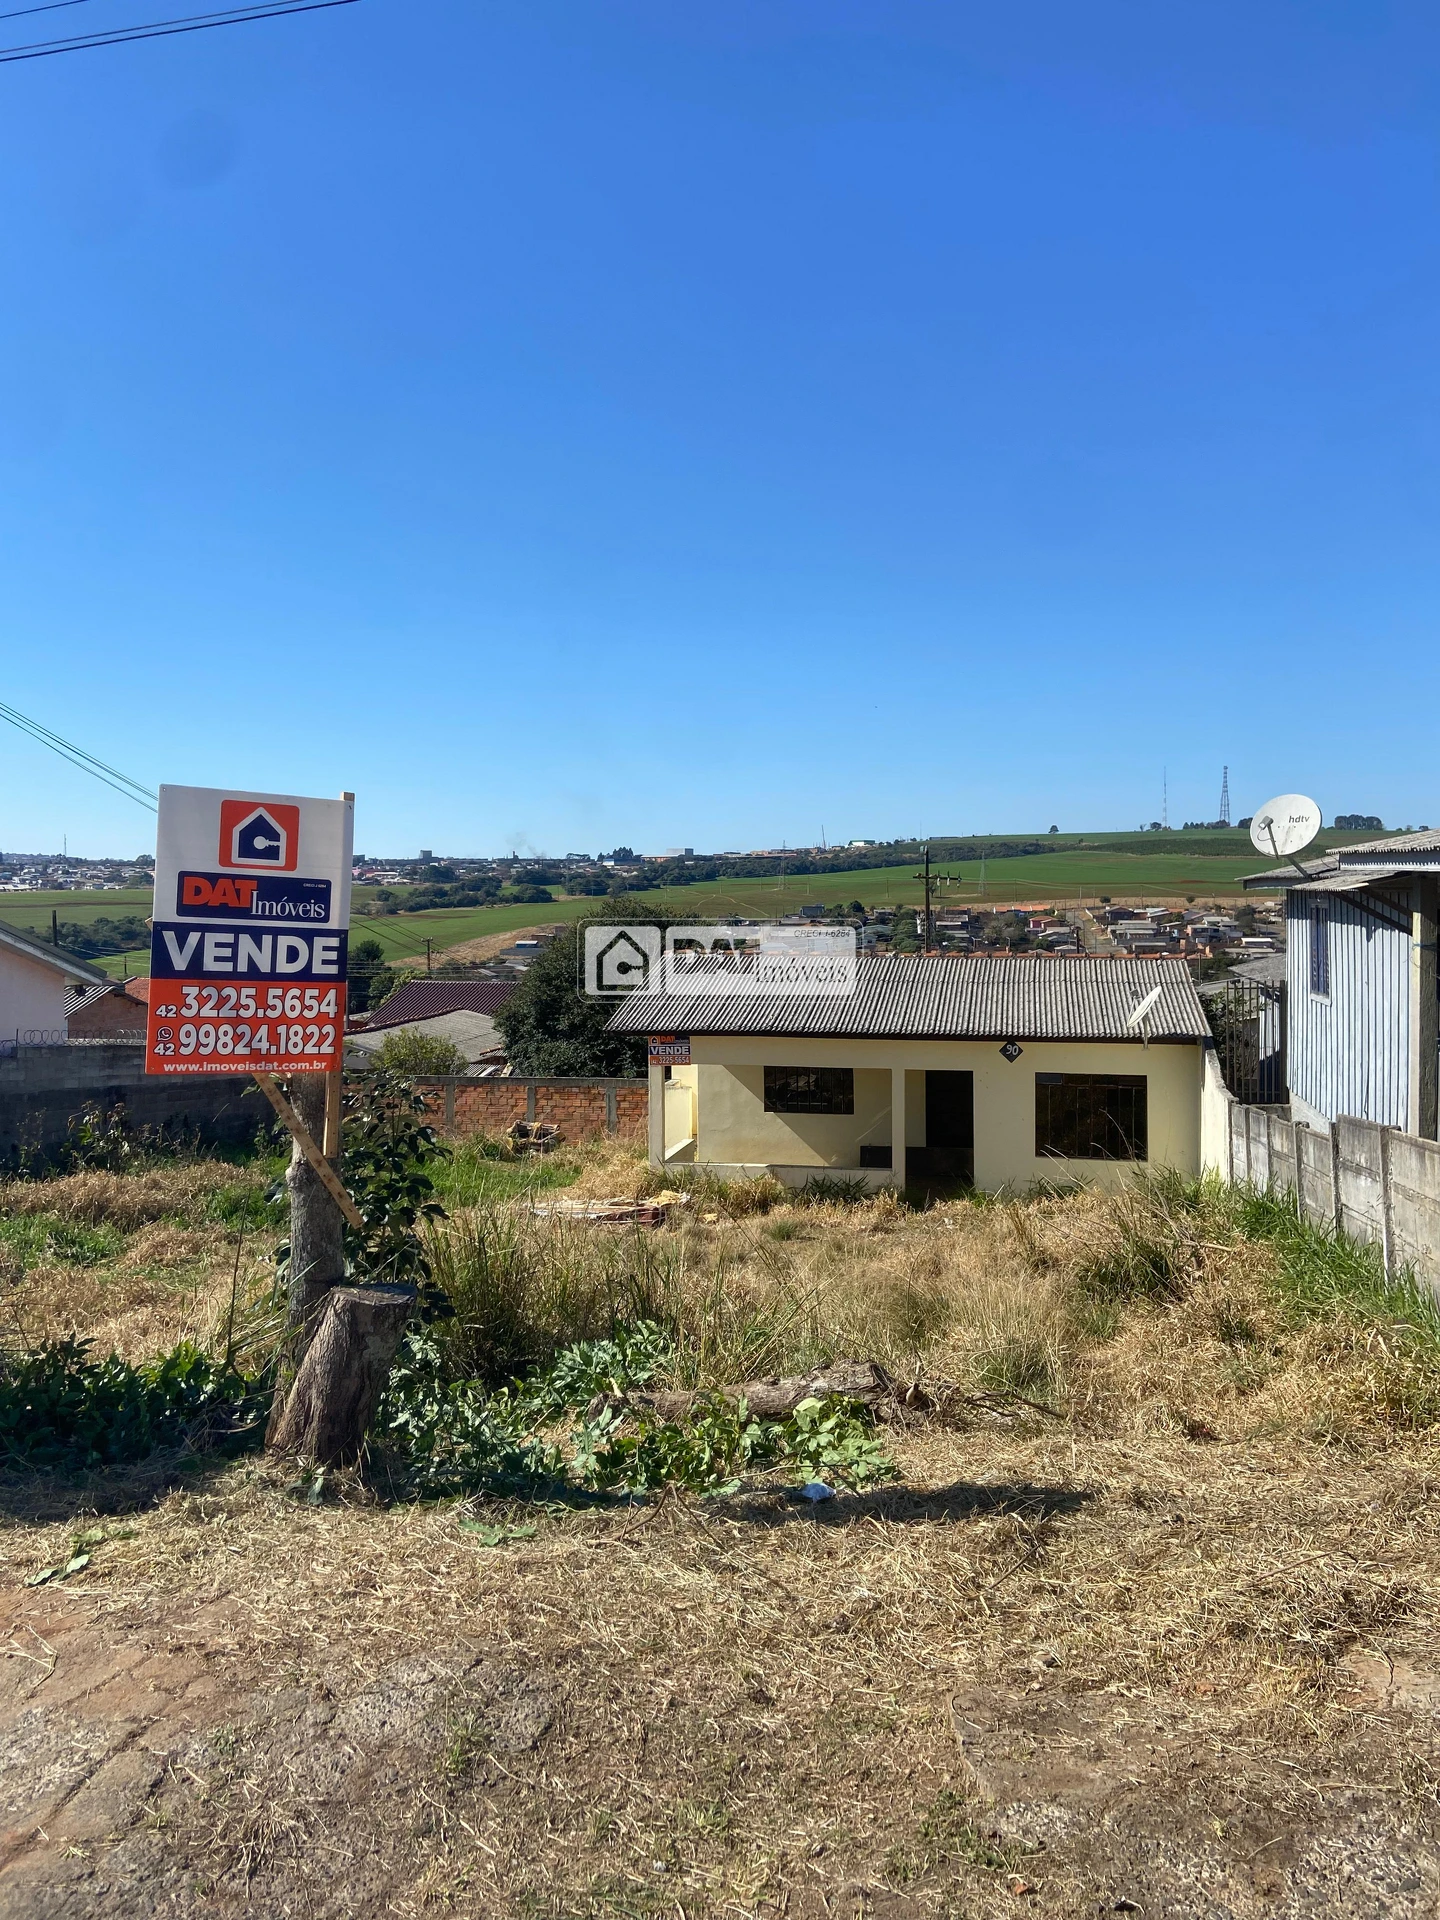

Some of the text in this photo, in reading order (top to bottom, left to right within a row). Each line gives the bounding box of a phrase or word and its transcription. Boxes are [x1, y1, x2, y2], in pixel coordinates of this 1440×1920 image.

[1289, 815, 1310, 823] hdtv
[182, 876, 258, 908] DAT
[250, 890, 325, 918] Imóveis
[162, 930, 340, 974] VENDE
[155, 985, 338, 1019] 42 3225.5654
[153, 1022, 337, 1056] 42 99824.1822
[650, 1046, 690, 1055] VENDE
[1005, 1044, 1019, 1056] 90
[163, 1060, 327, 1072] www.imoveisdat.com.br
